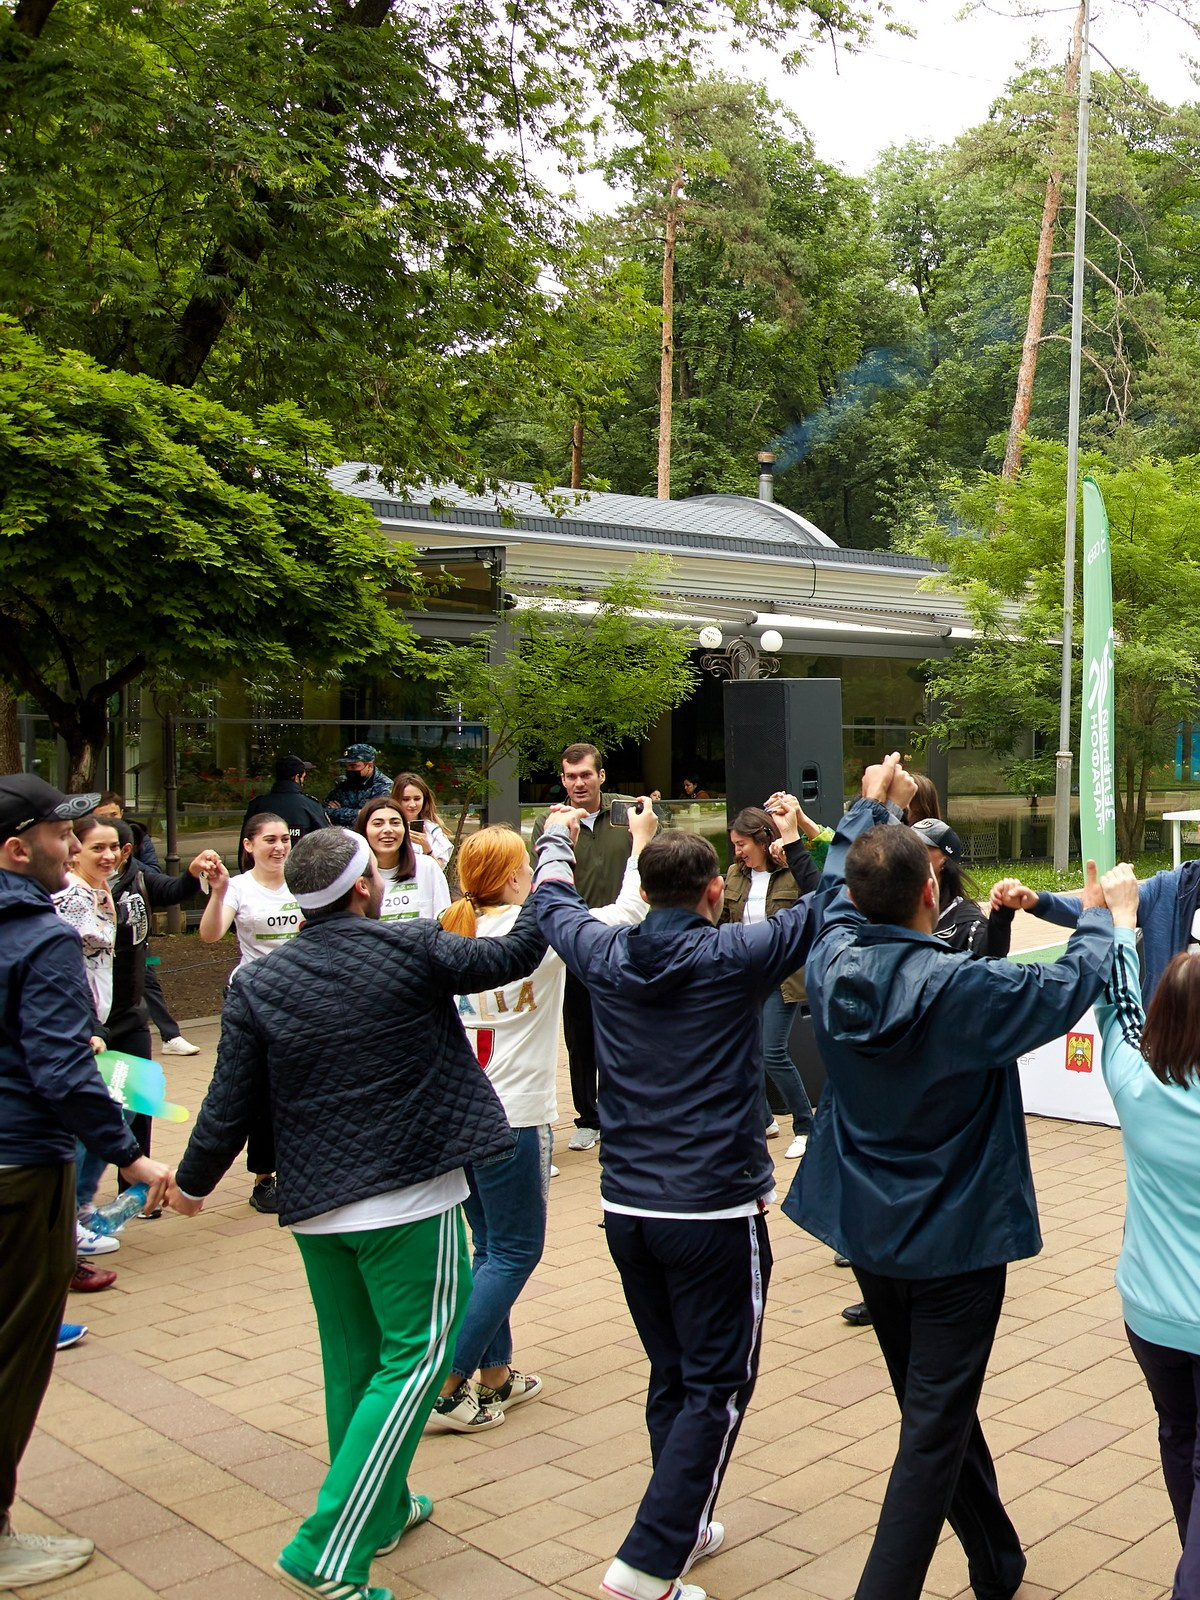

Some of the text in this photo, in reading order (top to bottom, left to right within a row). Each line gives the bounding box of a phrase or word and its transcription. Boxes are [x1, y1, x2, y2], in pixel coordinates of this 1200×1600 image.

[289, 828, 300, 837] ИЯ
[384, 895, 410, 908] 200
[267, 914, 298, 927] 0170
[458, 980, 538, 1022] ALIA
